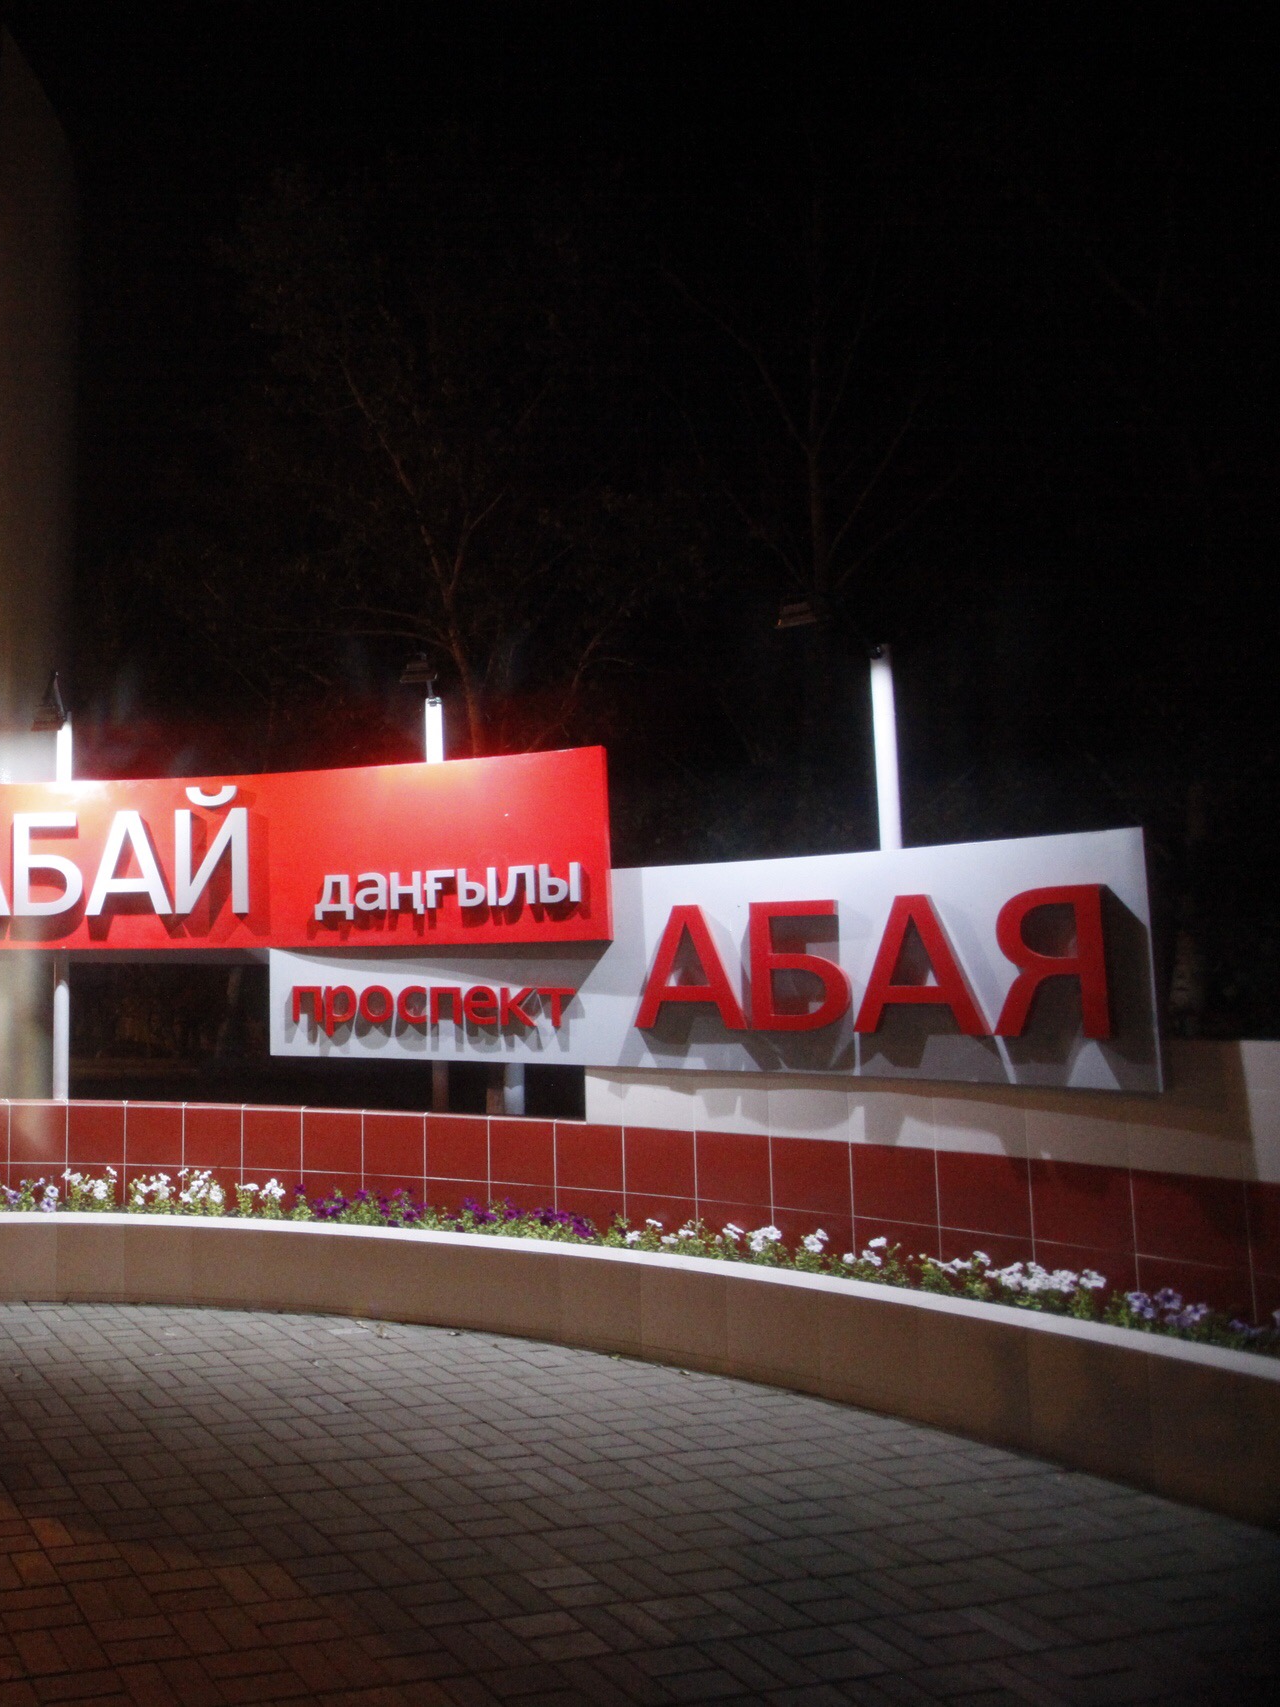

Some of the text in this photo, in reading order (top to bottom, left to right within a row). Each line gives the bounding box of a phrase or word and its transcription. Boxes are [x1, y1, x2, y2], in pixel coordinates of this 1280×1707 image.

[314, 861, 582, 920] даңғылы
[292, 883, 1111, 1039] проспект АБАЯ
